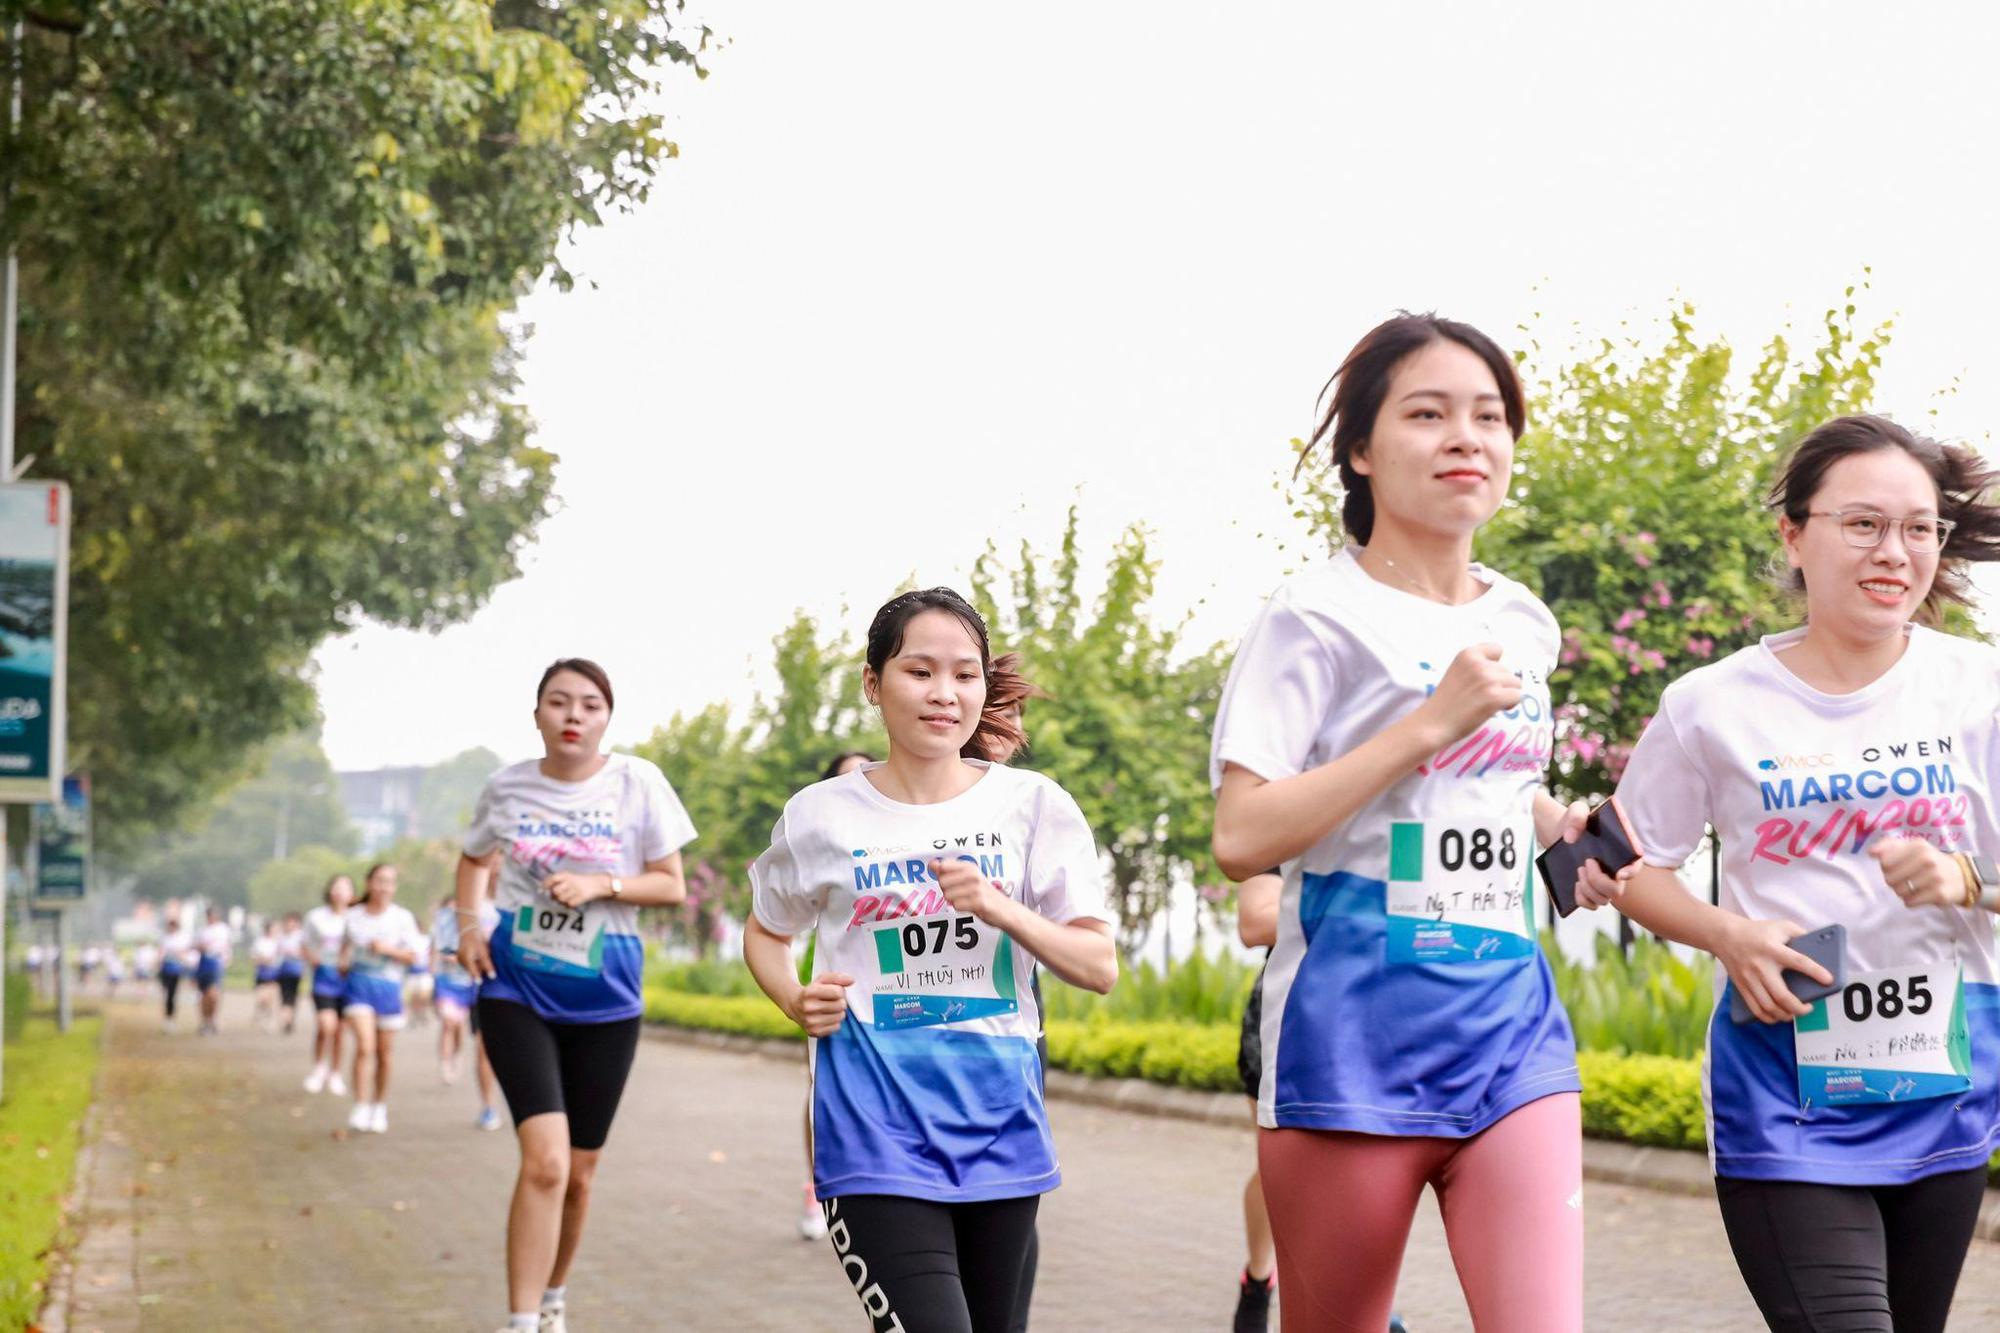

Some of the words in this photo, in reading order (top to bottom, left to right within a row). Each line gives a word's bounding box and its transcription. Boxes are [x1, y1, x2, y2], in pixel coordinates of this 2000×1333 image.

[1416, 727, 1514, 779] UN
[1862, 736, 1952, 762] OWEN
[1759, 764, 1955, 811] MARCOM
[933, 832, 1002, 850] OWEN
[1440, 827, 1516, 871] 088
[1750, 807, 1882, 865] RUN
[854, 854, 1004, 891] MARM
[540, 911, 584, 933] 074
[902, 916, 979, 957] 075
[1843, 975, 1933, 1022] 085
